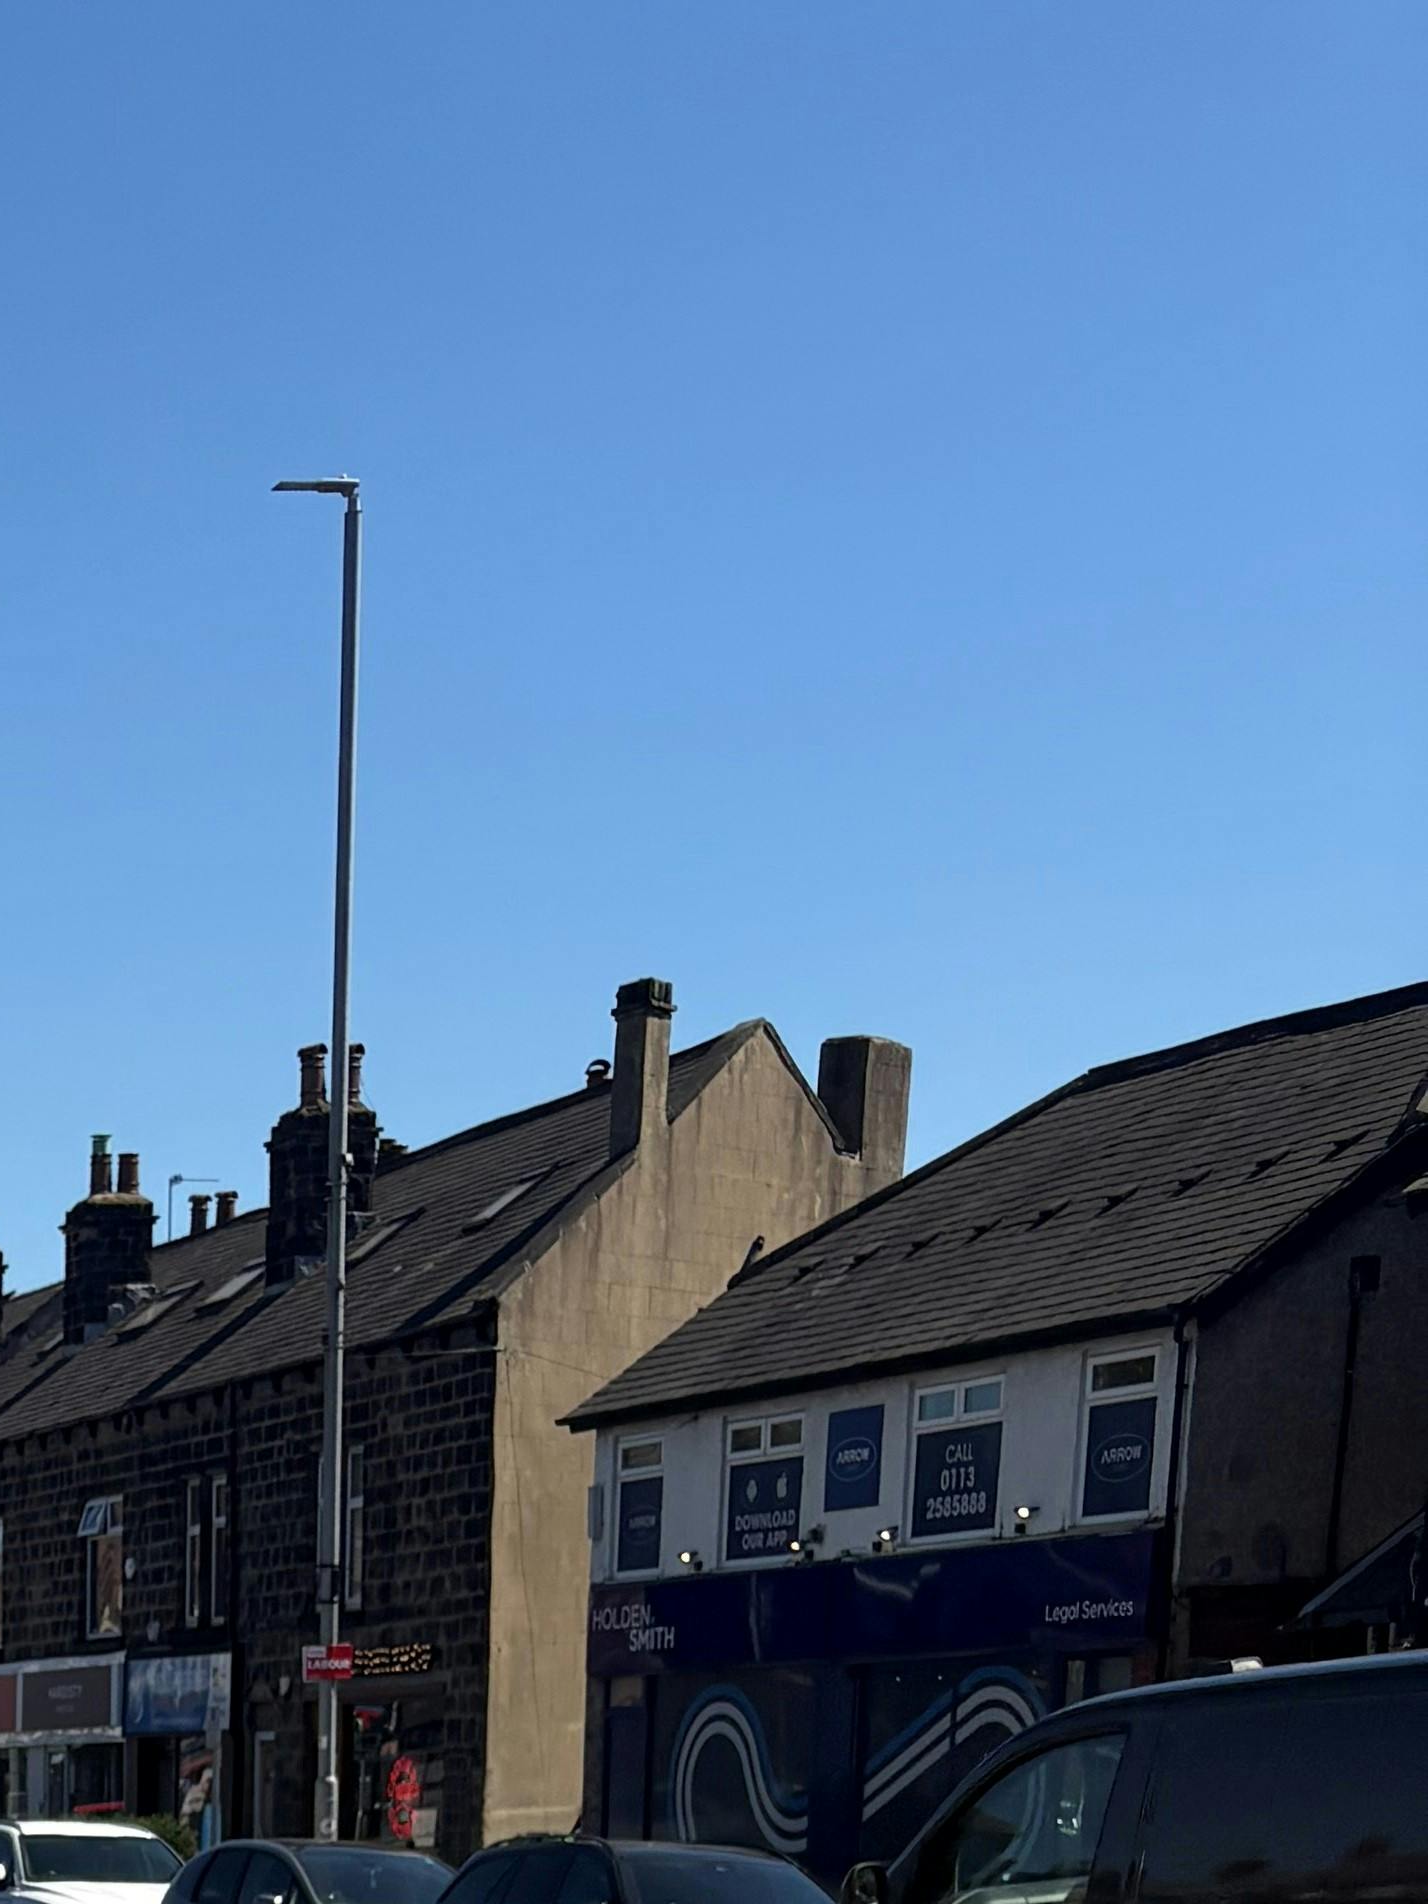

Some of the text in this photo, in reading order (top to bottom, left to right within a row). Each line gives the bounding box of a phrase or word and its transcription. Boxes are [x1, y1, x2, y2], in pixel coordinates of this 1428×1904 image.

[835, 1447, 871, 1465] ARROW
[945, 1443, 973, 1464] CALL
[1100, 1444, 1142, 1465] ARROW
[940, 1466, 975, 1491] 0113
[926, 1491, 987, 1520] 2585888
[734, 1508, 796, 1532] DOWNLOAD
[741, 1529, 787, 1550] OUR APP
[1044, 1599, 1134, 1624] Legal Services
[628, 1626, 676, 1653] SMITH
[307, 1659, 350, 1670] LABOUR
